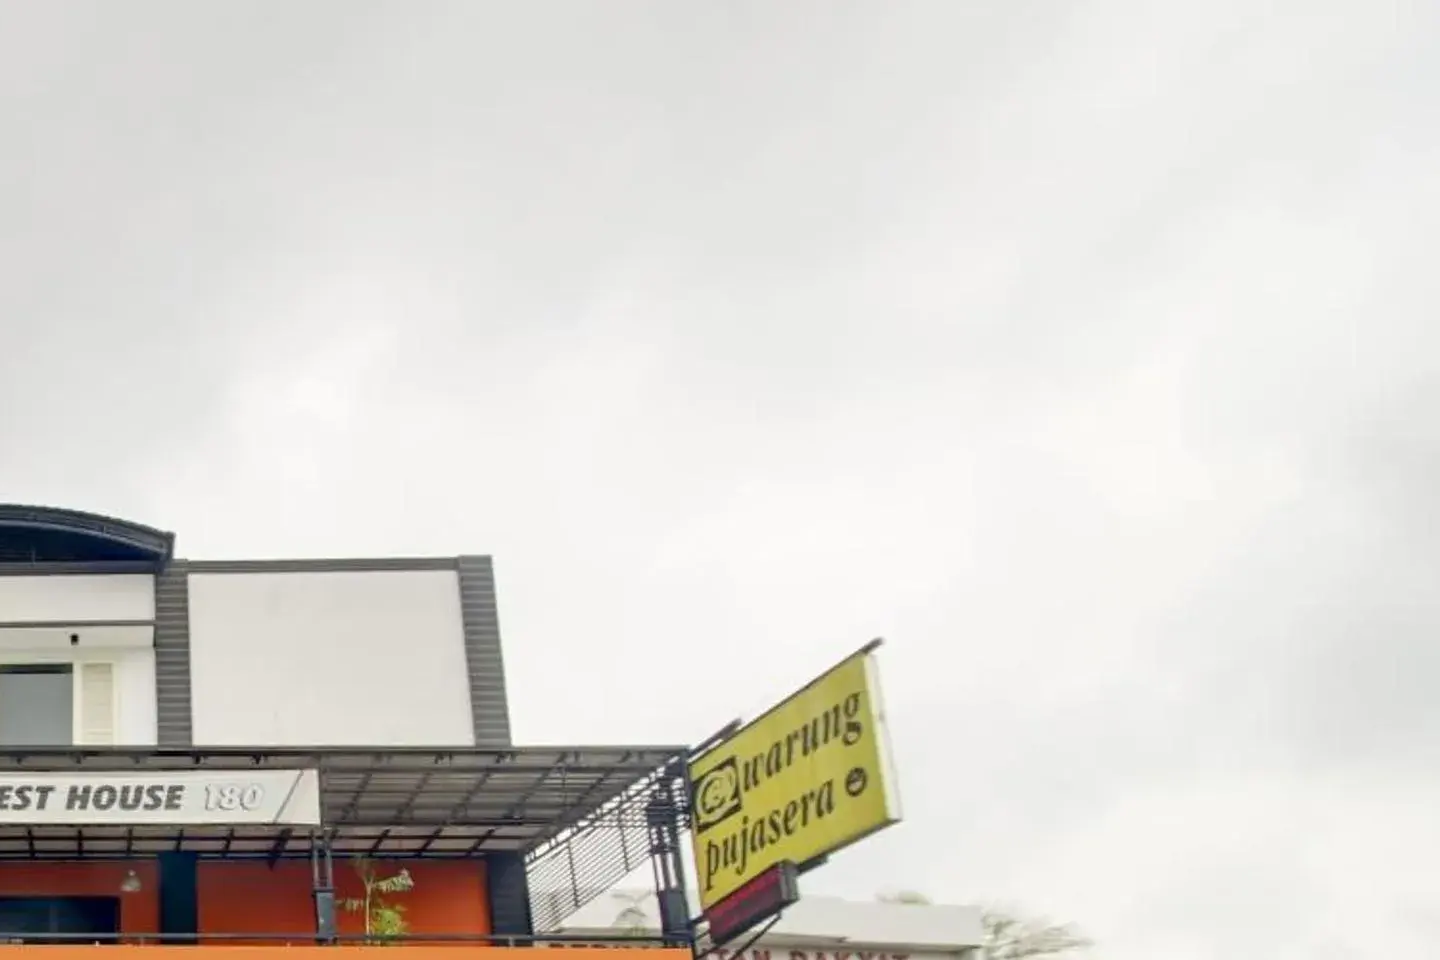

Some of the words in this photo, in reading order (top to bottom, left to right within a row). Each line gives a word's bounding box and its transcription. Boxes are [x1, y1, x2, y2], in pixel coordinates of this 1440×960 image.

[743, 693, 862, 793] warung
[66, 785, 186, 810] HOUSE
[203, 783, 264, 811] 180
[705, 779, 834, 891] pujasera
